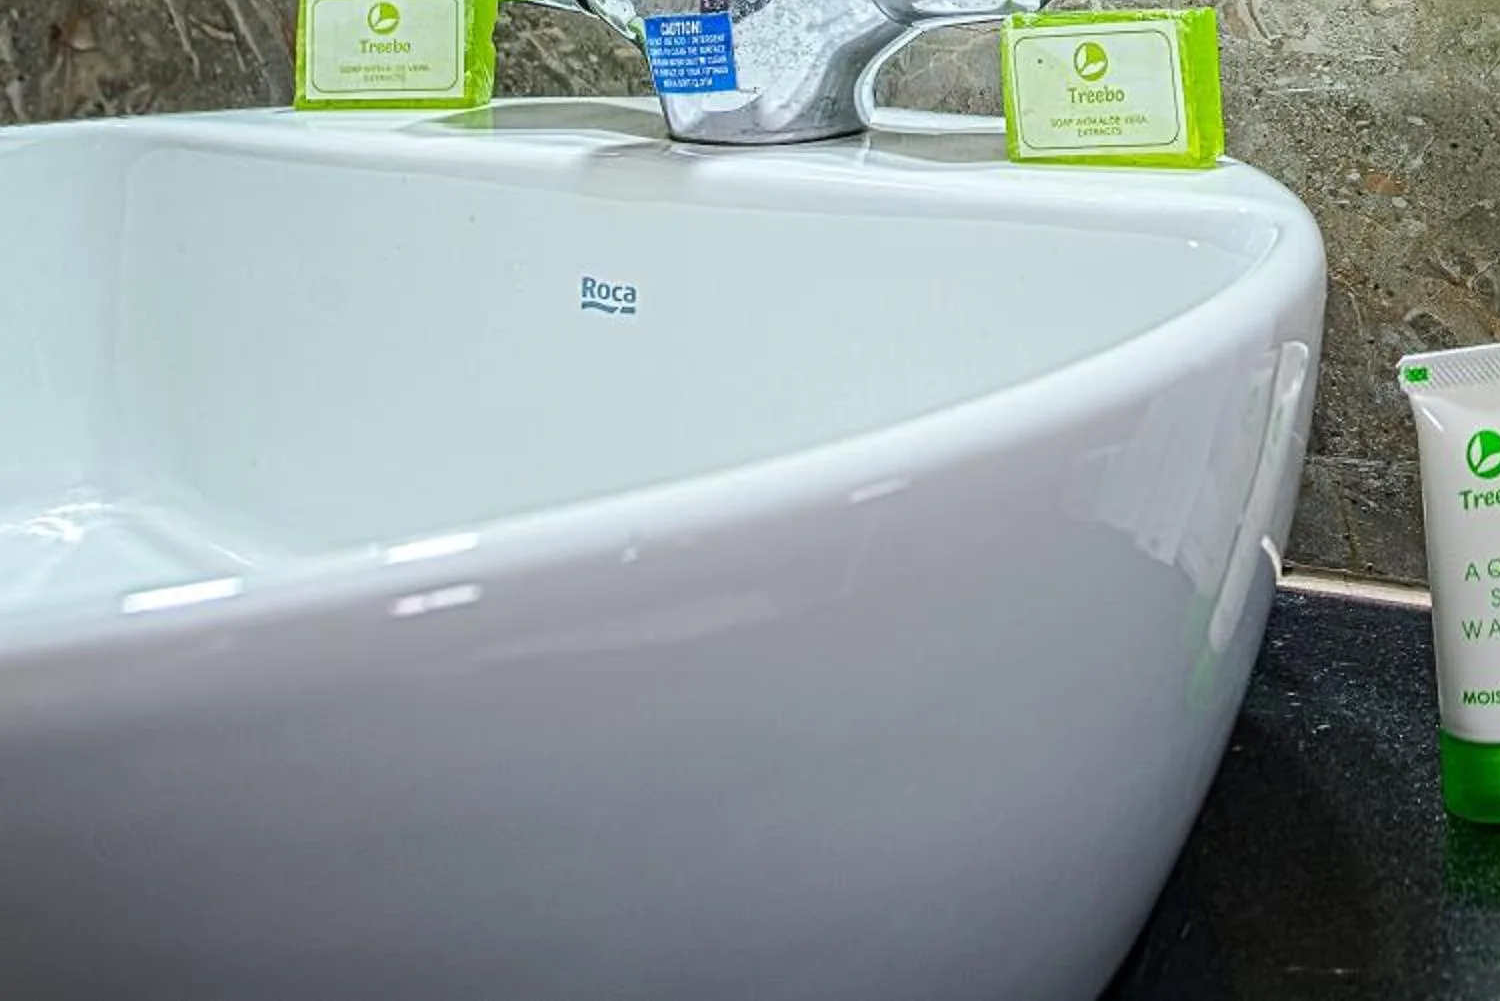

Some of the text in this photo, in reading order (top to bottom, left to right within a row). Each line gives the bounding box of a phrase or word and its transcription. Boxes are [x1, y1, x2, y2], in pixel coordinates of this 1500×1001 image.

[358, 38, 412, 54] Treebo
[1066, 84, 1125, 104] Treebo
[581, 276, 637, 304] Roca
